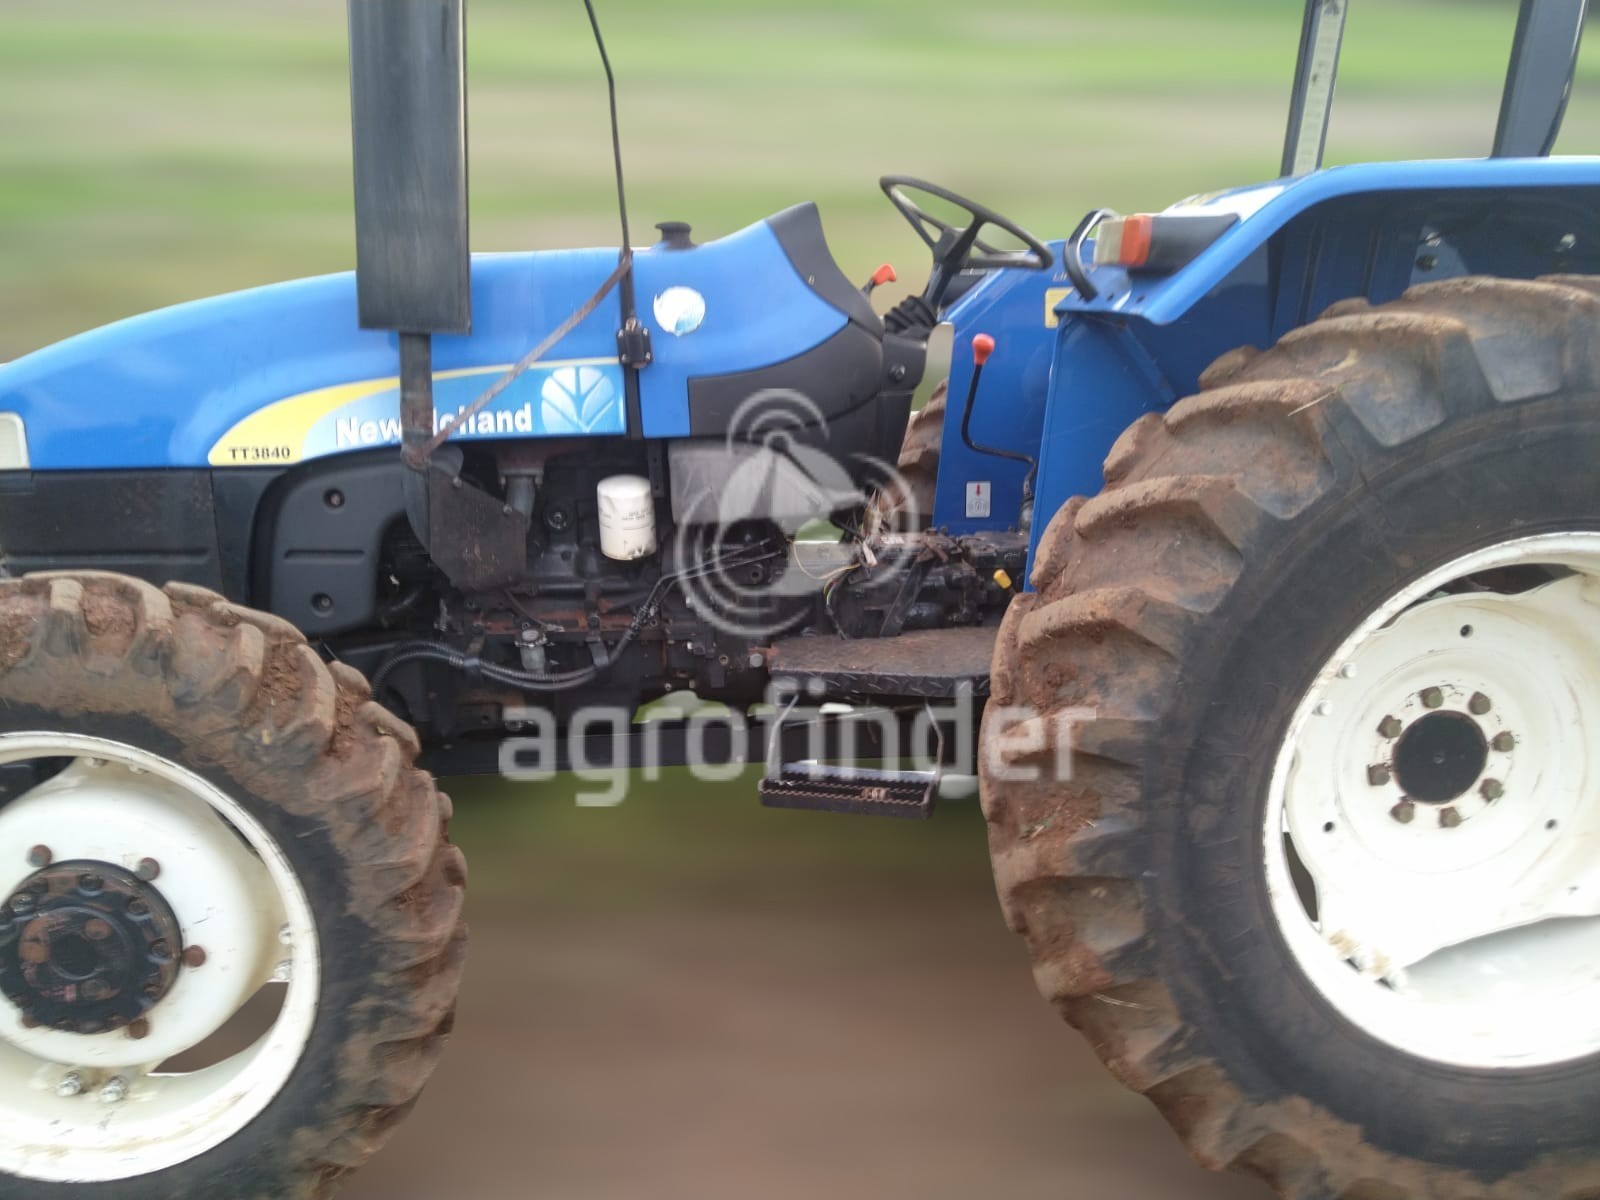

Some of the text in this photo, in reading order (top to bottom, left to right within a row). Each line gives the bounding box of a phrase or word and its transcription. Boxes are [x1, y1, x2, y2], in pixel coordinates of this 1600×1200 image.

[336, 402, 533, 448] New olland
[228, 446, 291, 460] TT3840
